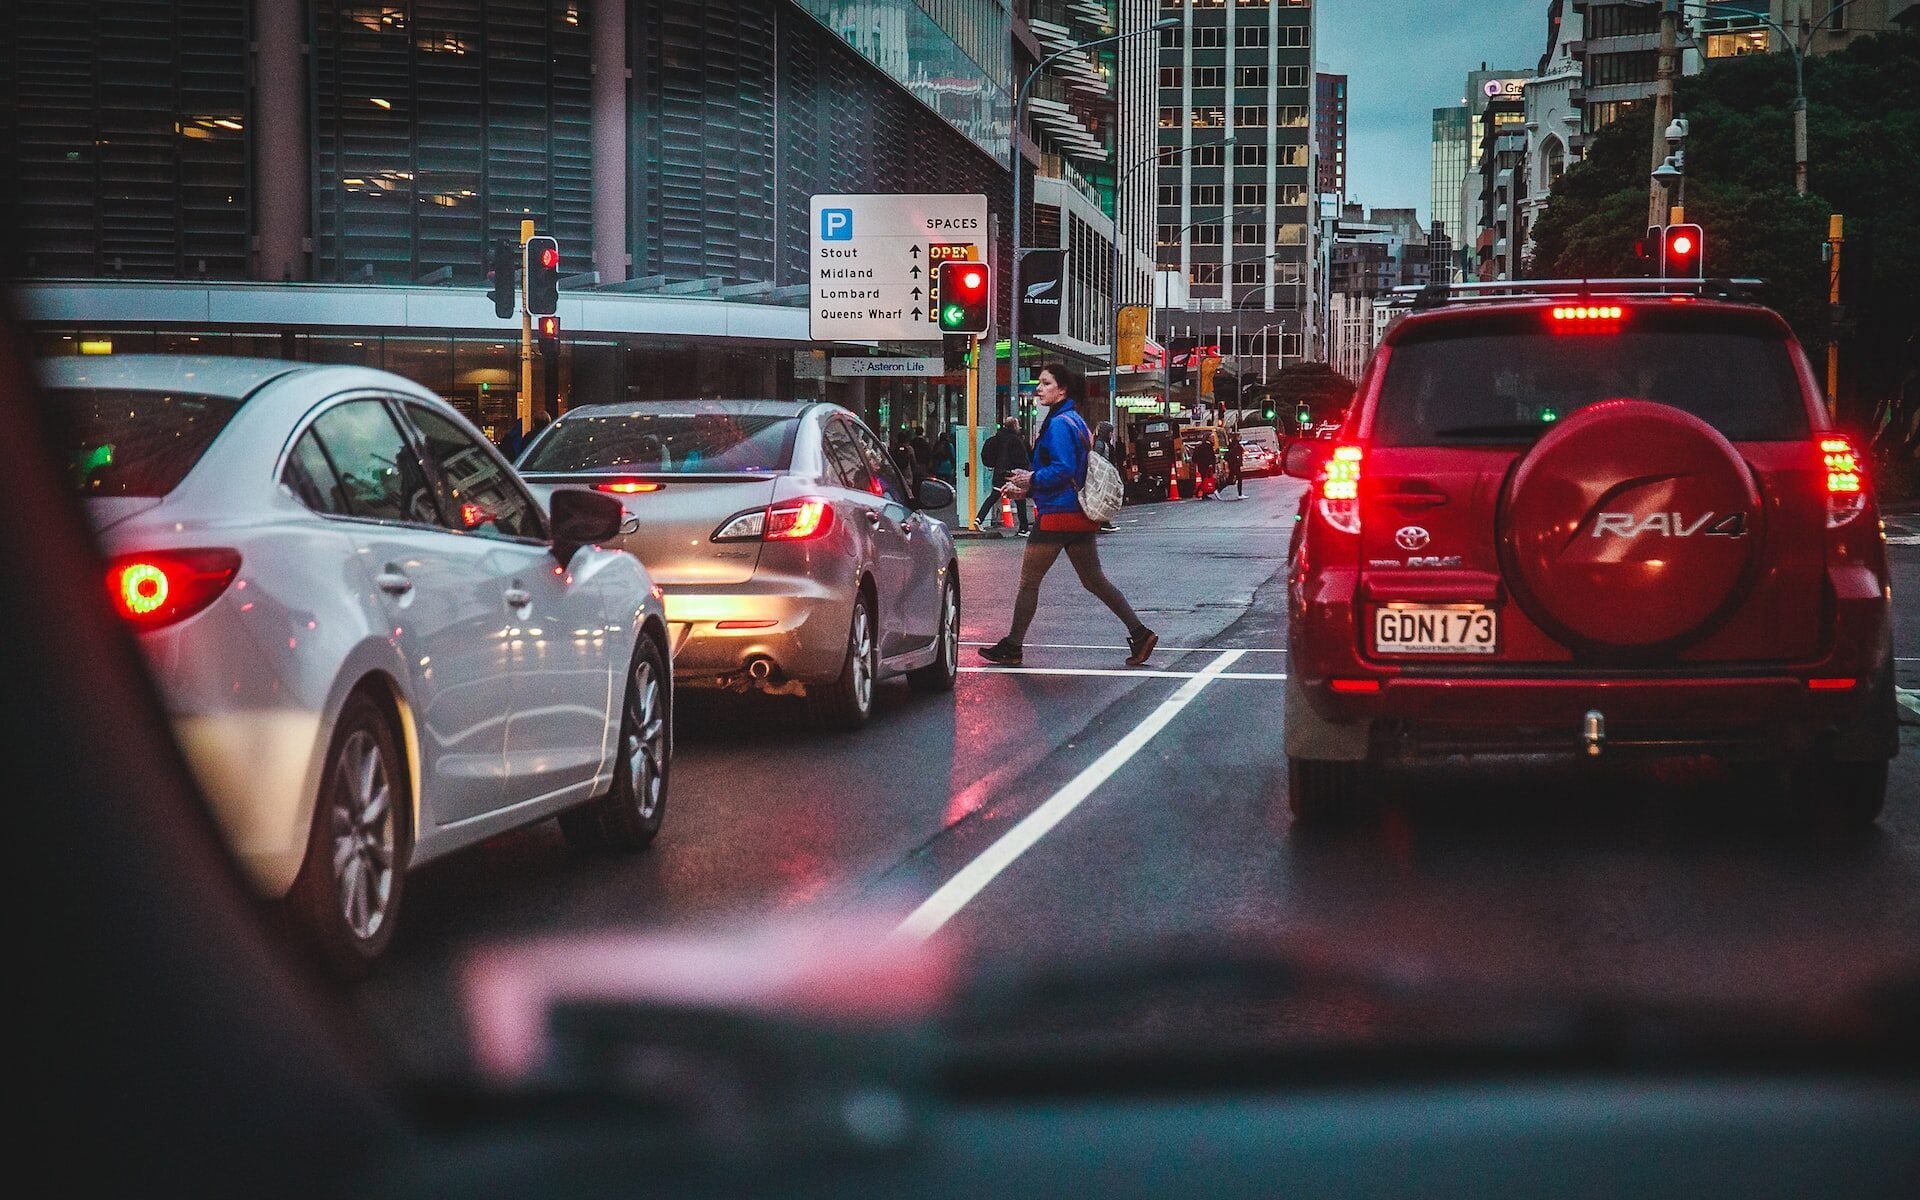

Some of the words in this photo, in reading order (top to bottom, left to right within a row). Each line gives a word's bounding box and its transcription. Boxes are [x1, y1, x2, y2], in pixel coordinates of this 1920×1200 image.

[827, 212, 847, 237] P
[926, 218, 978, 229] SPACES
[820, 248, 858, 258] Stout
[820, 268, 873, 279] Midland
[820, 289, 880, 299] Lombard
[820, 309, 863, 319] Queens
[868, 309, 902, 319] Wharf
[867, 362, 905, 371] Asteron
[906, 362, 925, 371] Life
[1592, 511, 1748, 539] RAV4
[1380, 614, 1493, 643] GDN173
